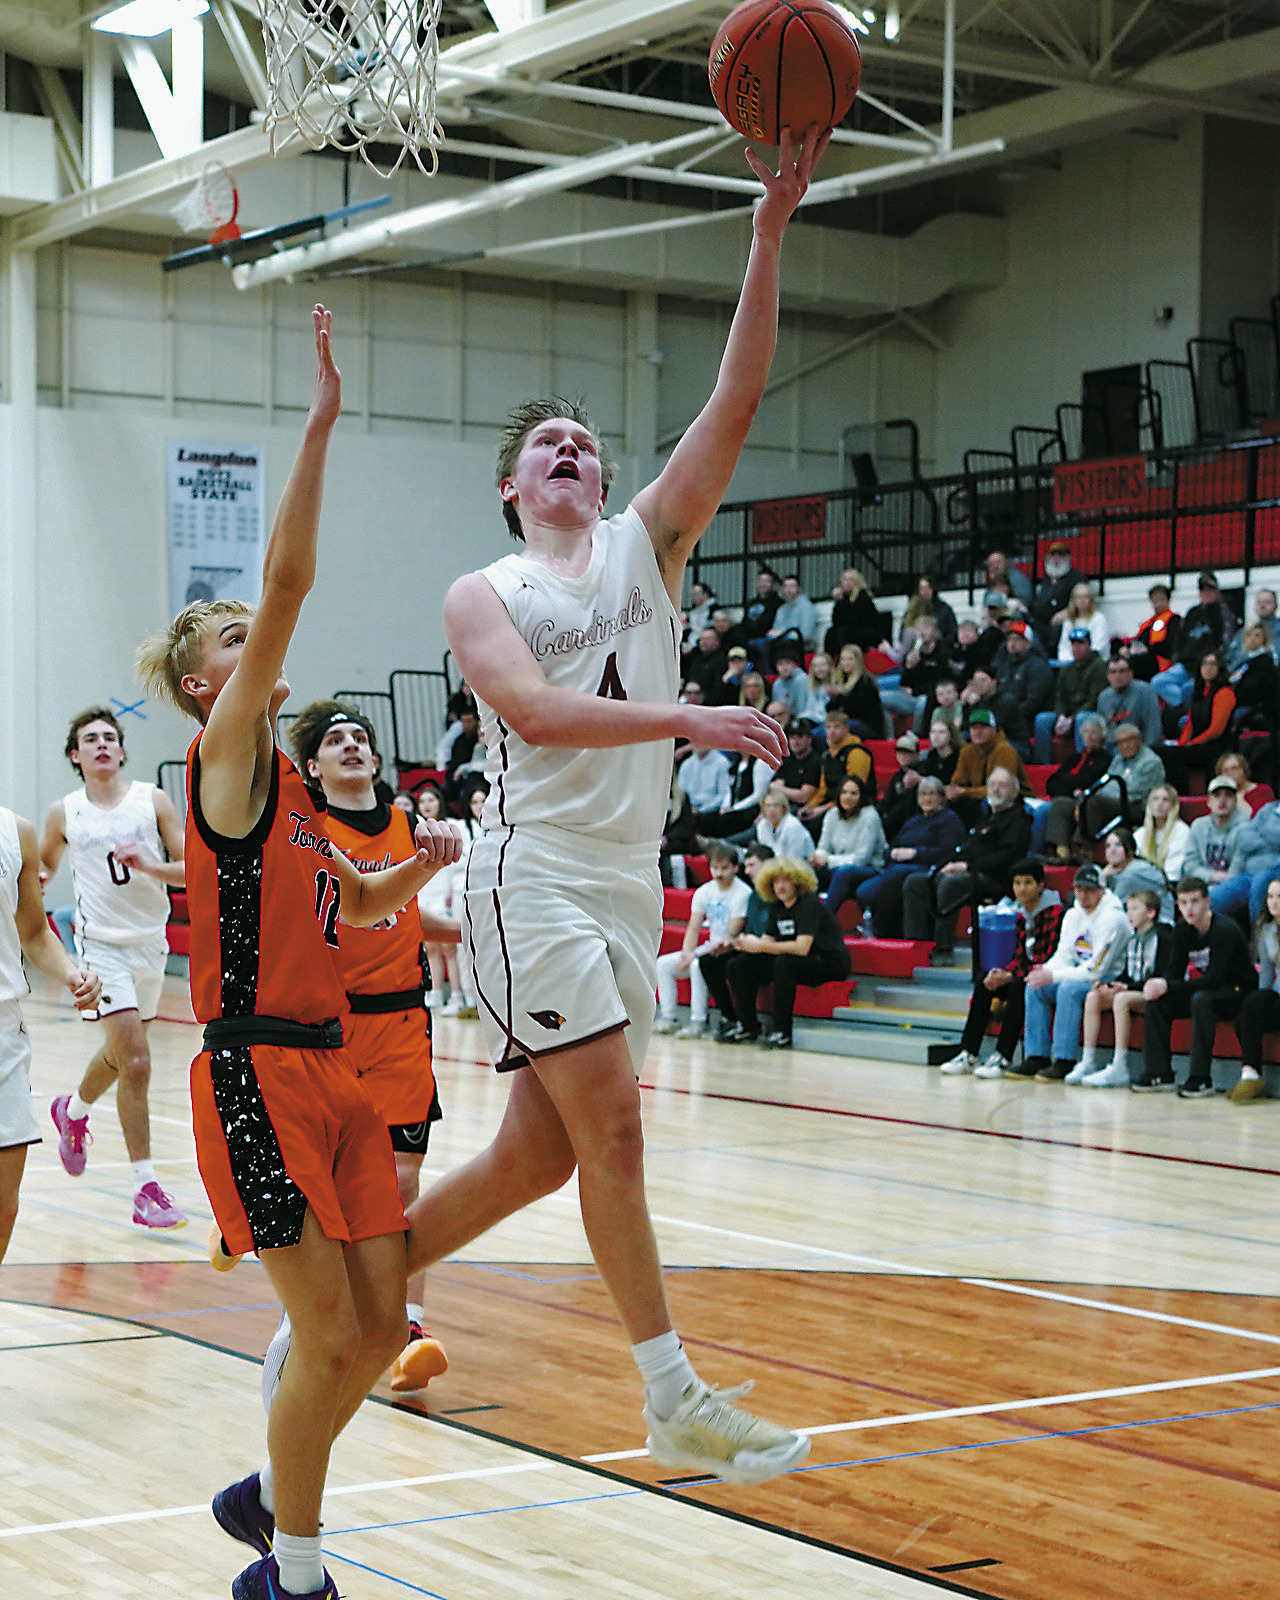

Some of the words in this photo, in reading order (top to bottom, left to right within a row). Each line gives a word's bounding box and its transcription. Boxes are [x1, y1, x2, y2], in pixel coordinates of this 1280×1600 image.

[177, 448, 258, 467] Langdon
[178, 476, 253, 491] BASKETBALL
[191, 488, 237, 501] STATE
[1057, 463, 1141, 505] VISITORS
[756, 502, 822, 537] VISITORS
[531, 585, 653, 662] Cardinals
